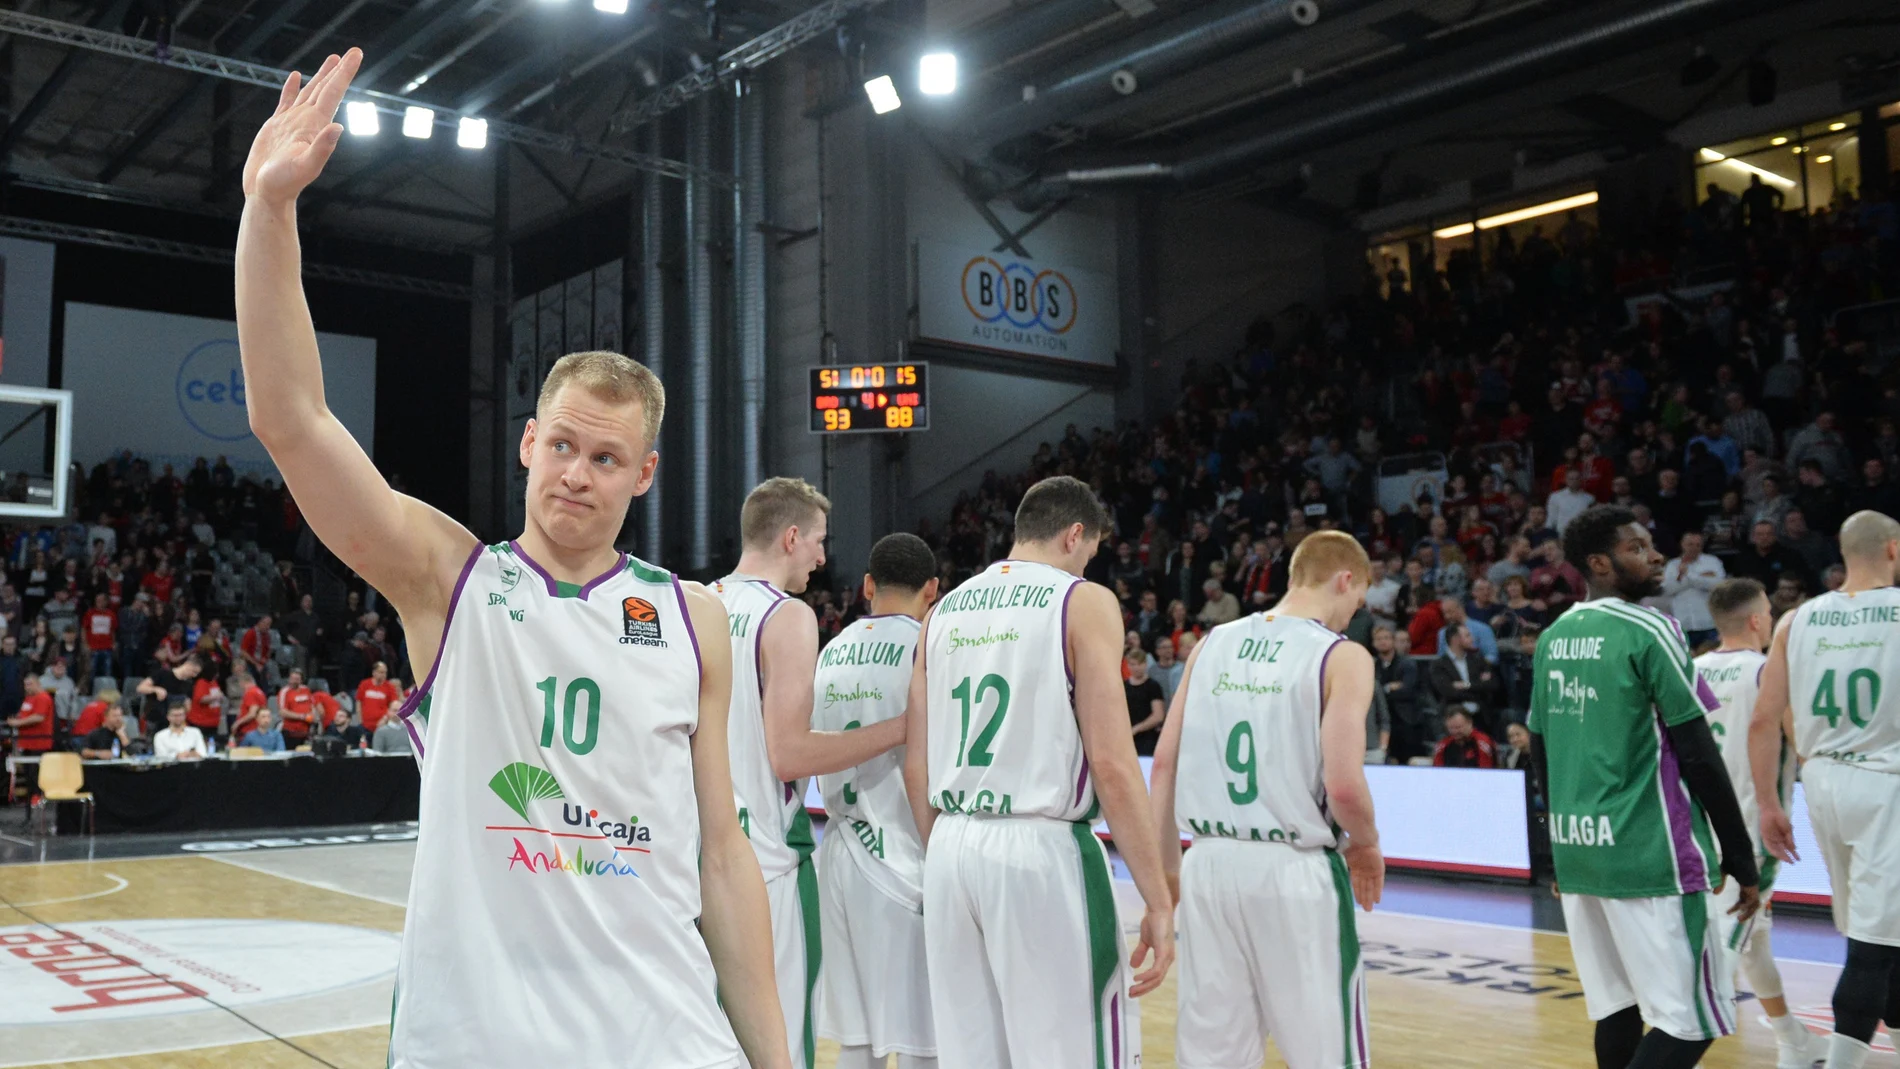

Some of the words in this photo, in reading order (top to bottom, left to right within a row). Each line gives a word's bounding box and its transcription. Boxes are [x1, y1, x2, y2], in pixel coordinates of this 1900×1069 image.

[979, 271, 1060, 318] BBS
[972, 325, 1068, 351] AUTOMATION
[824, 408, 851, 431] 93
[885, 406, 913, 428] 88
[938, 583, 1057, 616] MILOSAVLJEVIĆ
[628, 625, 658, 633] AIRLINES
[1807, 606, 1900, 627] AUGUSTINE
[1237, 636, 1284, 663] DÍAZ
[1812, 667, 1881, 730] 40
[536, 676, 601, 756] 10
[952, 673, 1011, 768] 12
[1225, 720, 1259, 806] 9
[507, 836, 641, 879] Andalucía
